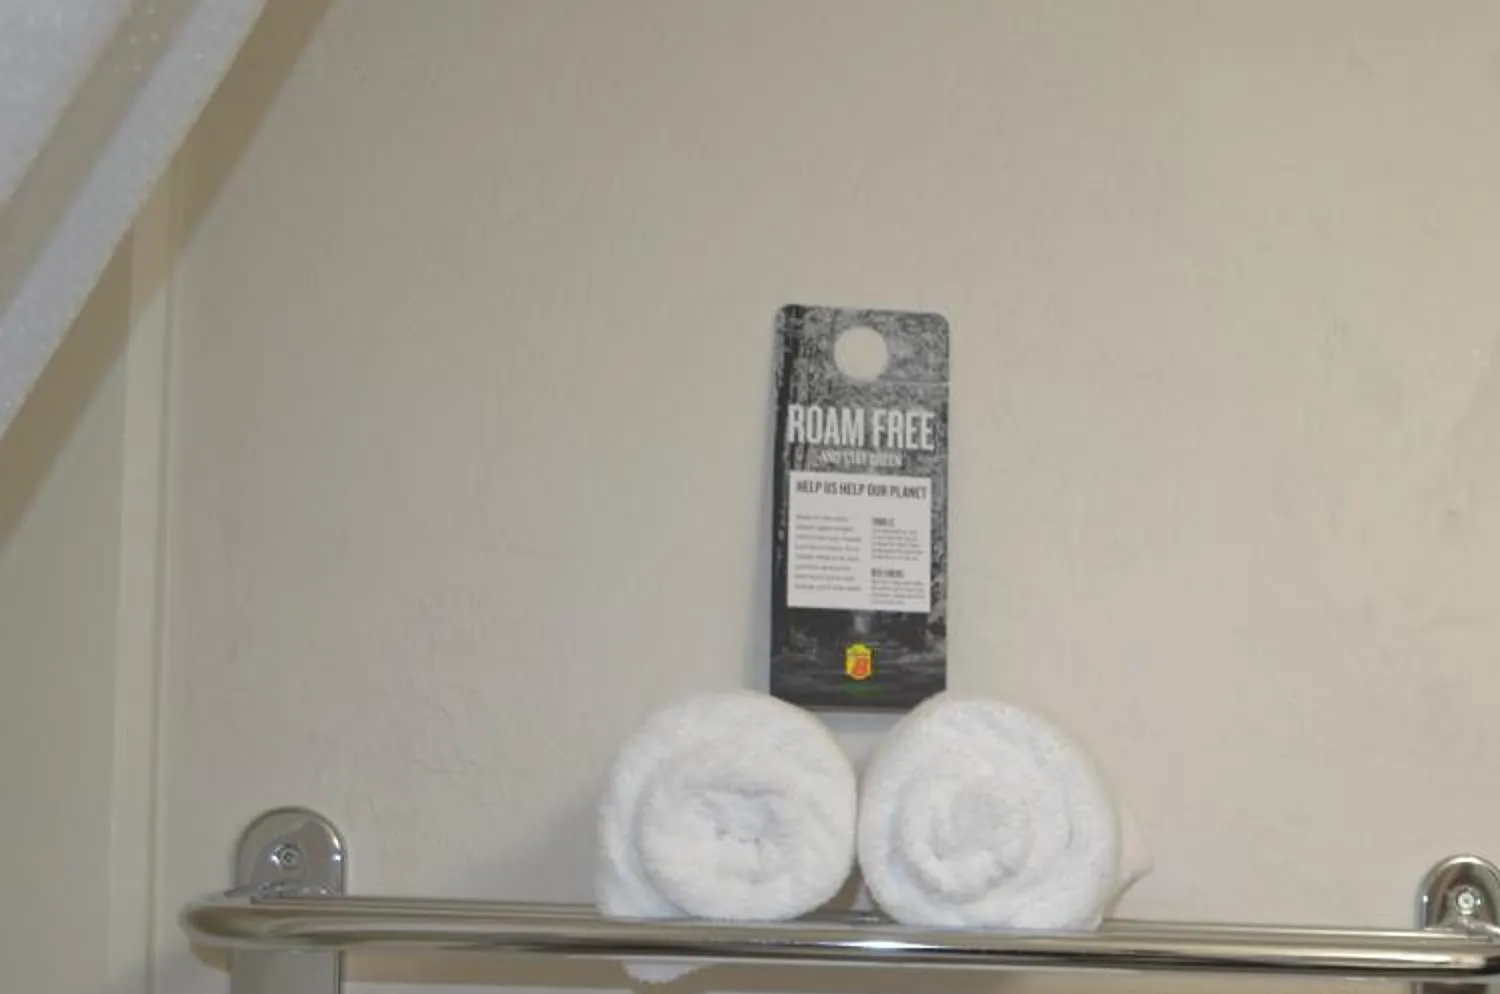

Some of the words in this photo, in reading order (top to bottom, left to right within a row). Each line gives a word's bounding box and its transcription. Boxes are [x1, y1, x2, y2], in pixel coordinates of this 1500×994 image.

[786, 404, 865, 447] ROAM
[872, 409, 936, 450] FREE
[796, 480, 821, 494] HELP
[824, 481, 838, 495] US
[839, 482, 865, 496] HELP
[867, 483, 887, 497] OUR
[889, 485, 927, 500] PLANET
